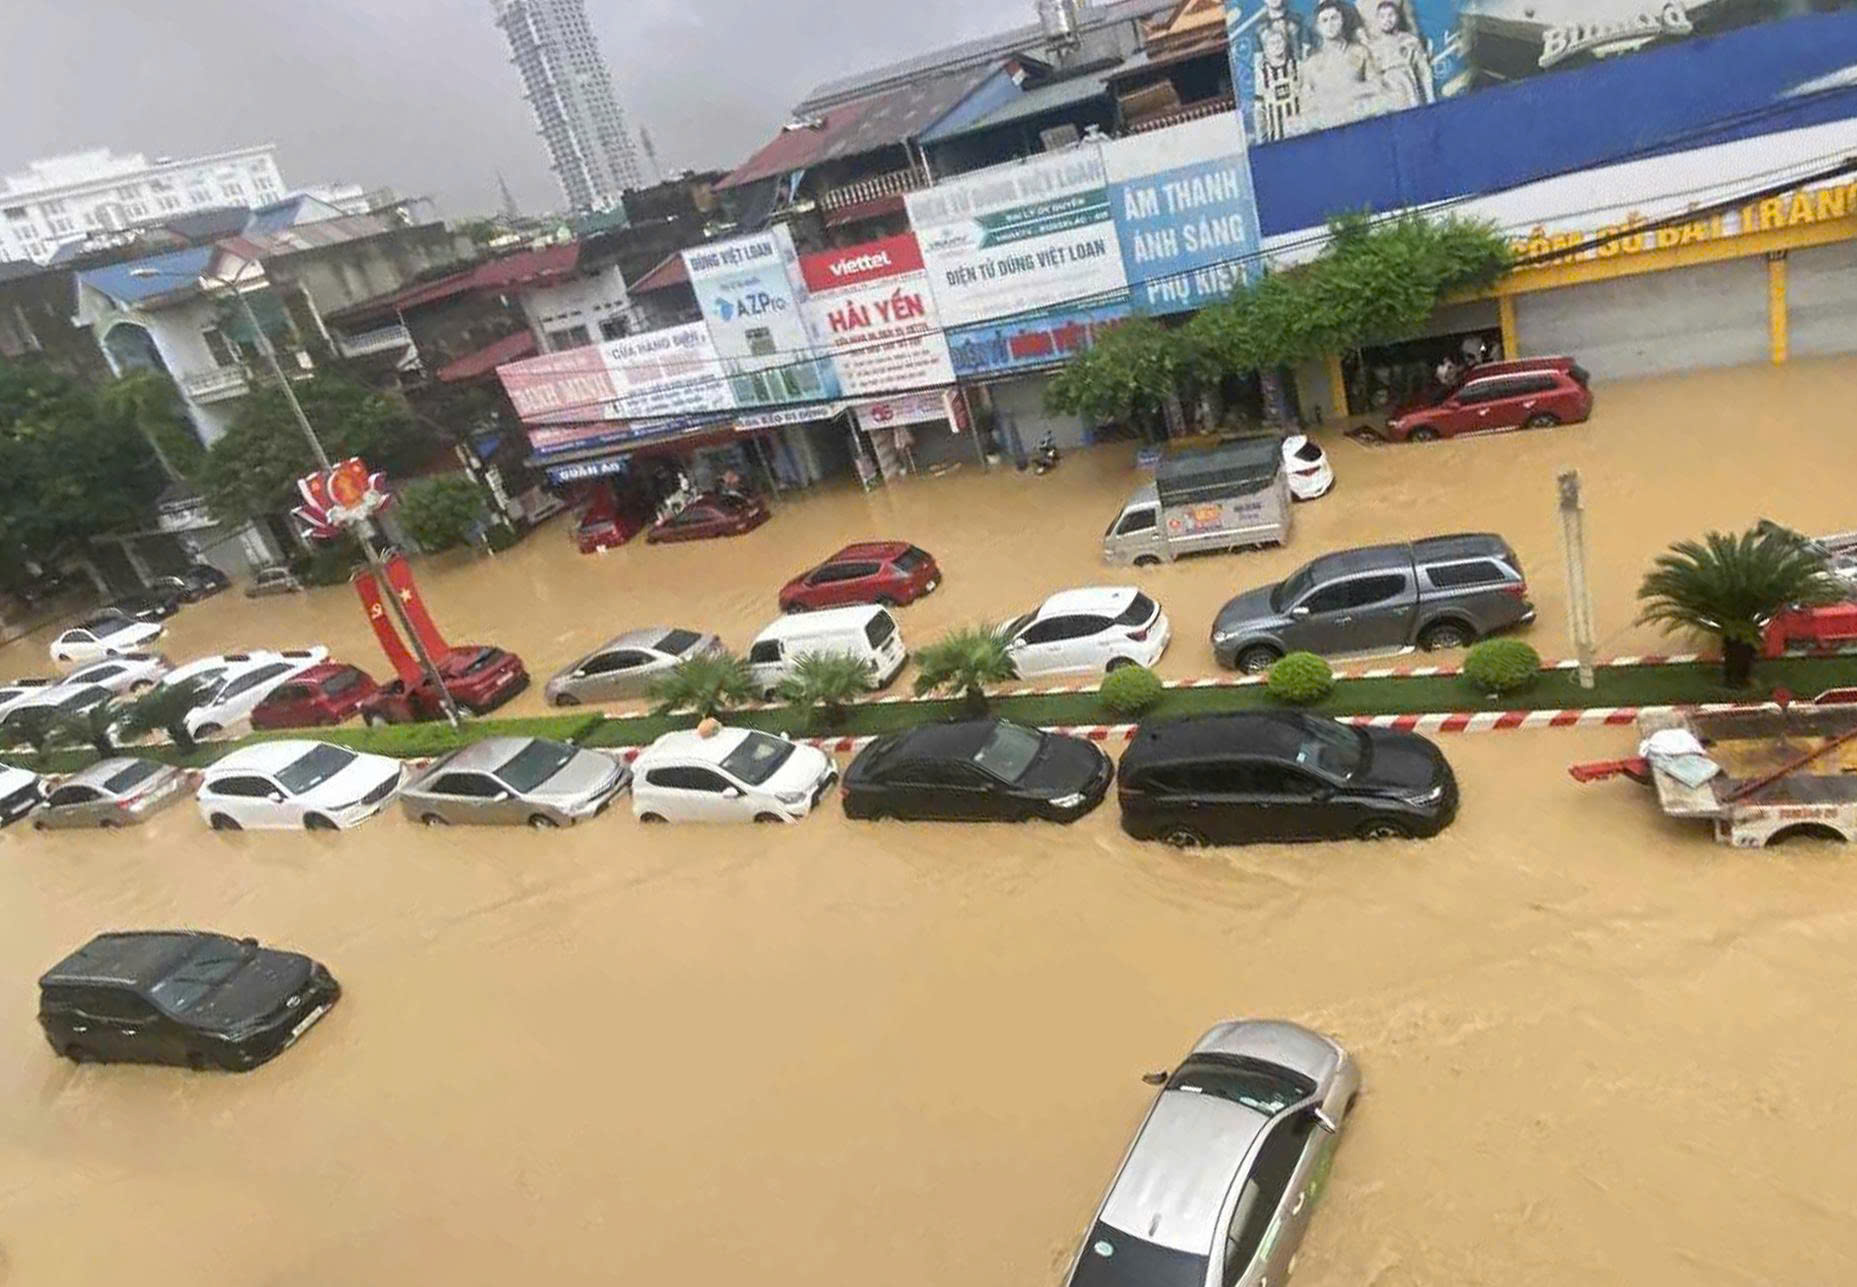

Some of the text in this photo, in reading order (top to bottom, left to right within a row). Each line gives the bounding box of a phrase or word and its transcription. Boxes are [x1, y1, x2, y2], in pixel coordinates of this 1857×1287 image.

[1124, 170, 1240, 221] ÂM THANH
[1134, 213, 1247, 264] ÁNH SÁNG
[828, 250, 892, 276] viettel
[946, 264, 977, 286] ĐIỆN
[980, 257, 996, 279] TỬ
[999, 254, 1035, 276] DŨNG
[1037, 248, 1065, 270] VIỆT
[1070, 239, 1106, 261] LOAN
[828, 287, 925, 332] HẢI YẾN
